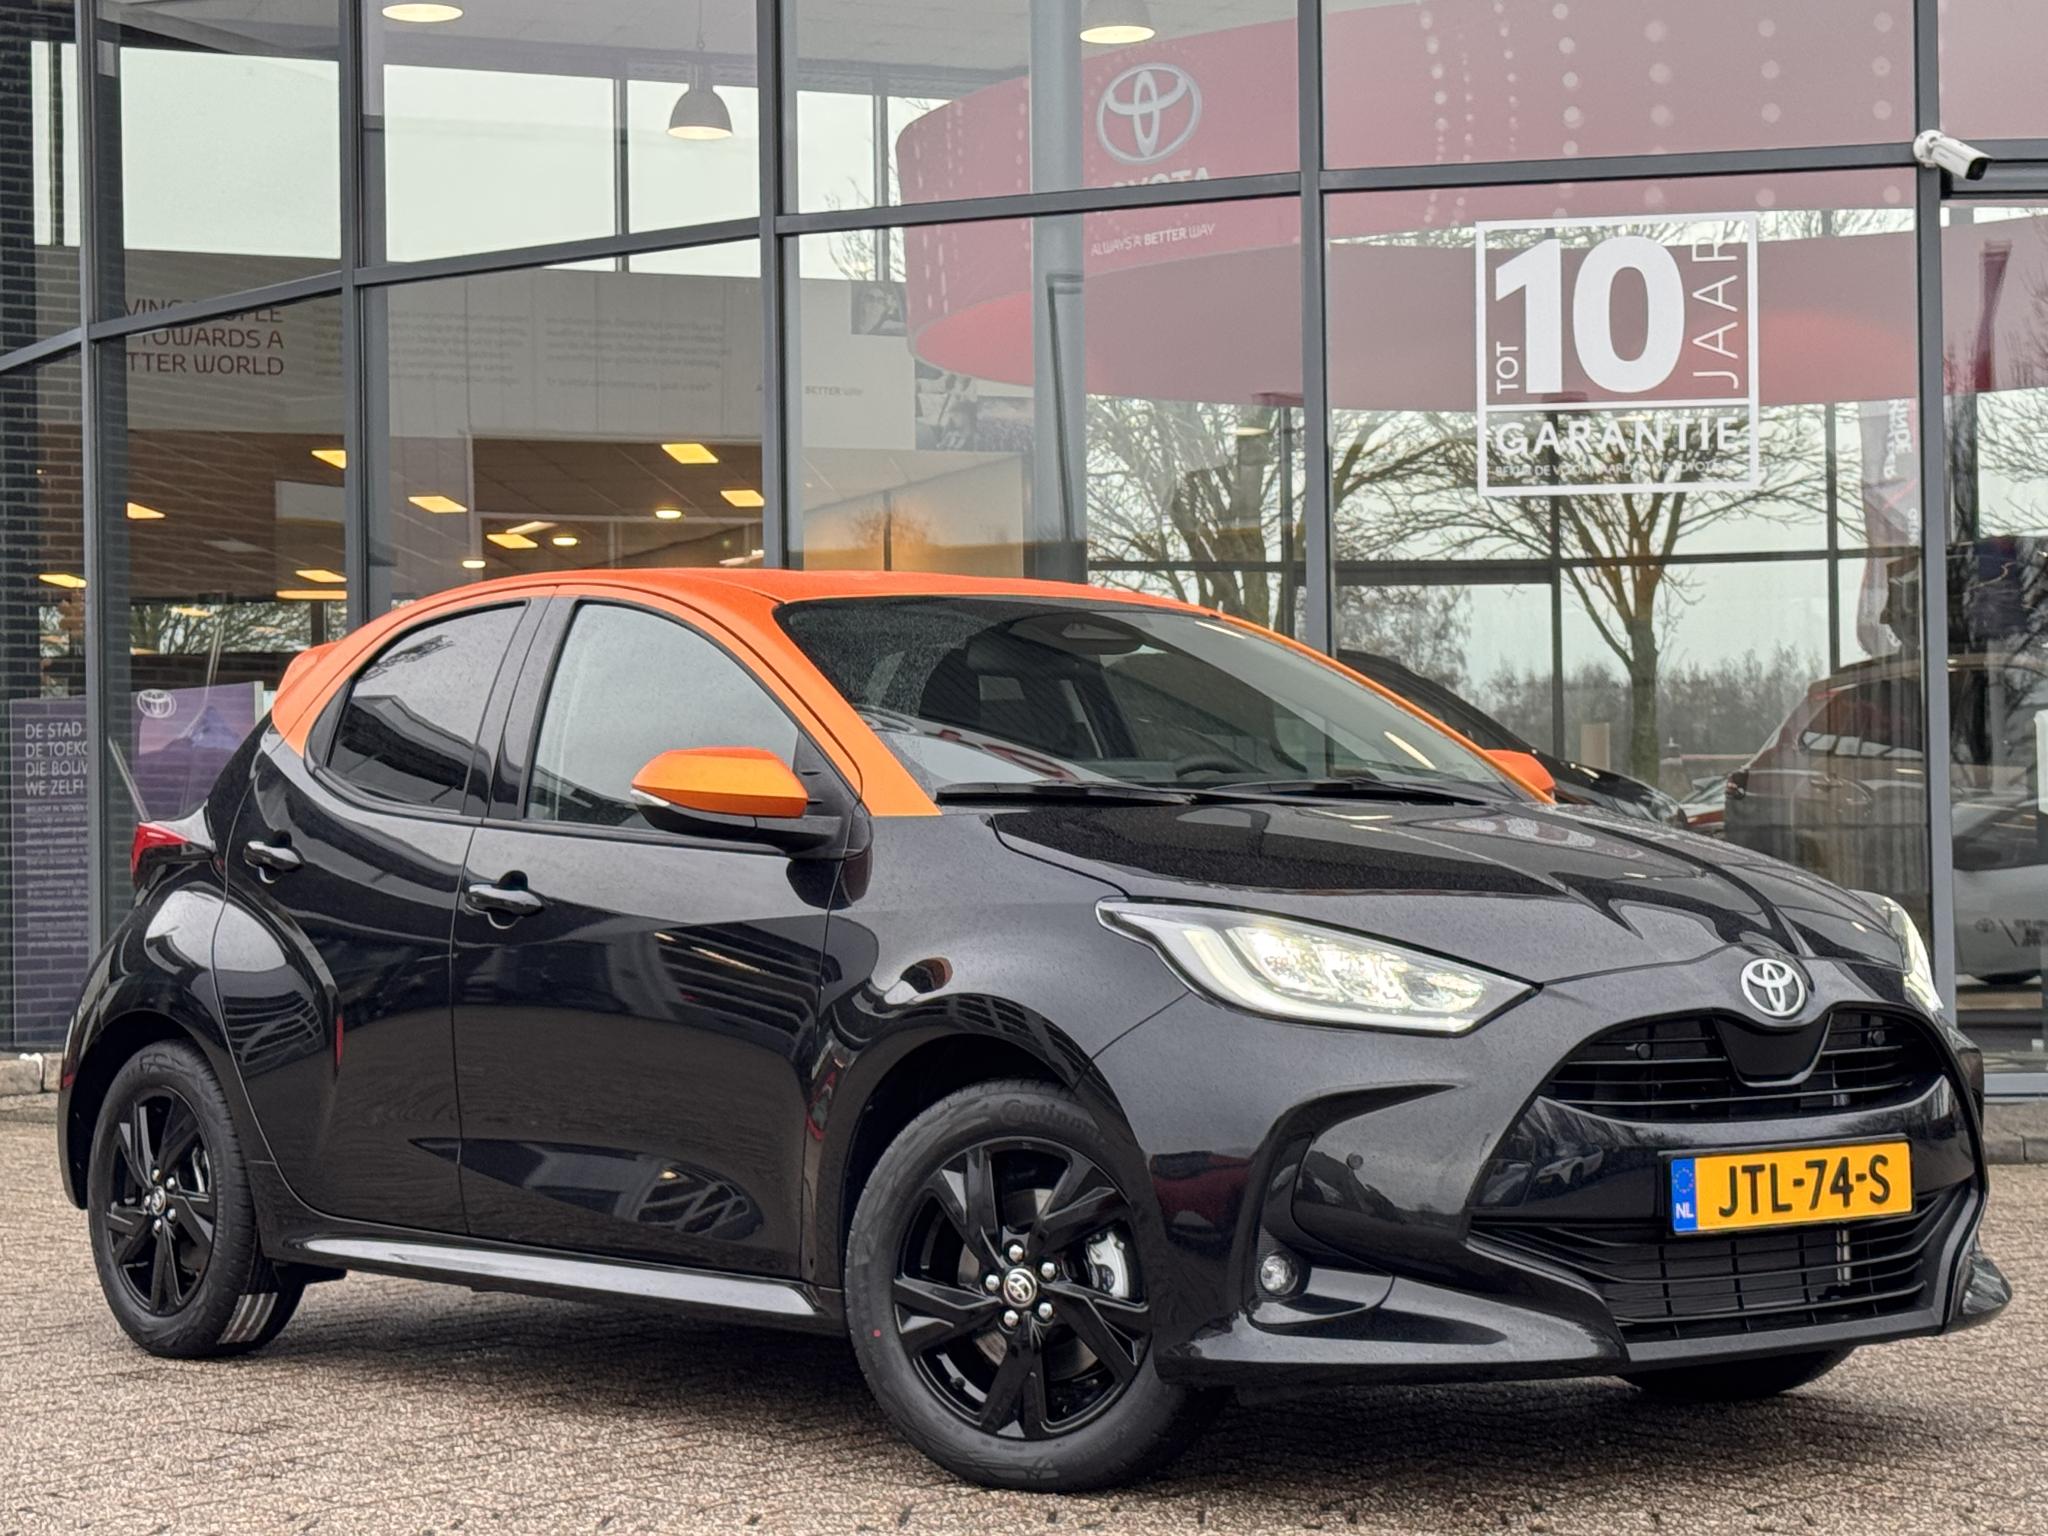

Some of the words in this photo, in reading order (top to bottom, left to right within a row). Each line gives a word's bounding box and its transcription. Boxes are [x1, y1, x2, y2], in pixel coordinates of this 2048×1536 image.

[1091, 235, 1132, 257] ALWAYS
[1132, 234, 1143, 249] A
[1144, 227, 1188, 246] BETTER
[1188, 223, 1216, 240] WAY
[1495, 235, 1685, 393] 10
[1691, 235, 1739, 390] JAAR
[266, 330, 284, 349] A
[127, 352, 187, 373] TTER
[194, 354, 284, 376] WORLD
[1495, 341, 1519, 394] TOT
[1496, 415, 1739, 456] GARANTIE
[1535, 464, 1551, 477] DE
[25, 723, 44, 740] DE
[47, 721, 82, 739] STAD
[25, 742, 44, 759] DE
[25, 761, 48, 778] DIE
[25, 780, 46, 797] WE
[50, 779, 84, 795] ZELF!
[1675, 1202, 1695, 1219] NL
[1718, 1154, 1891, 1218] JTL-74-S
